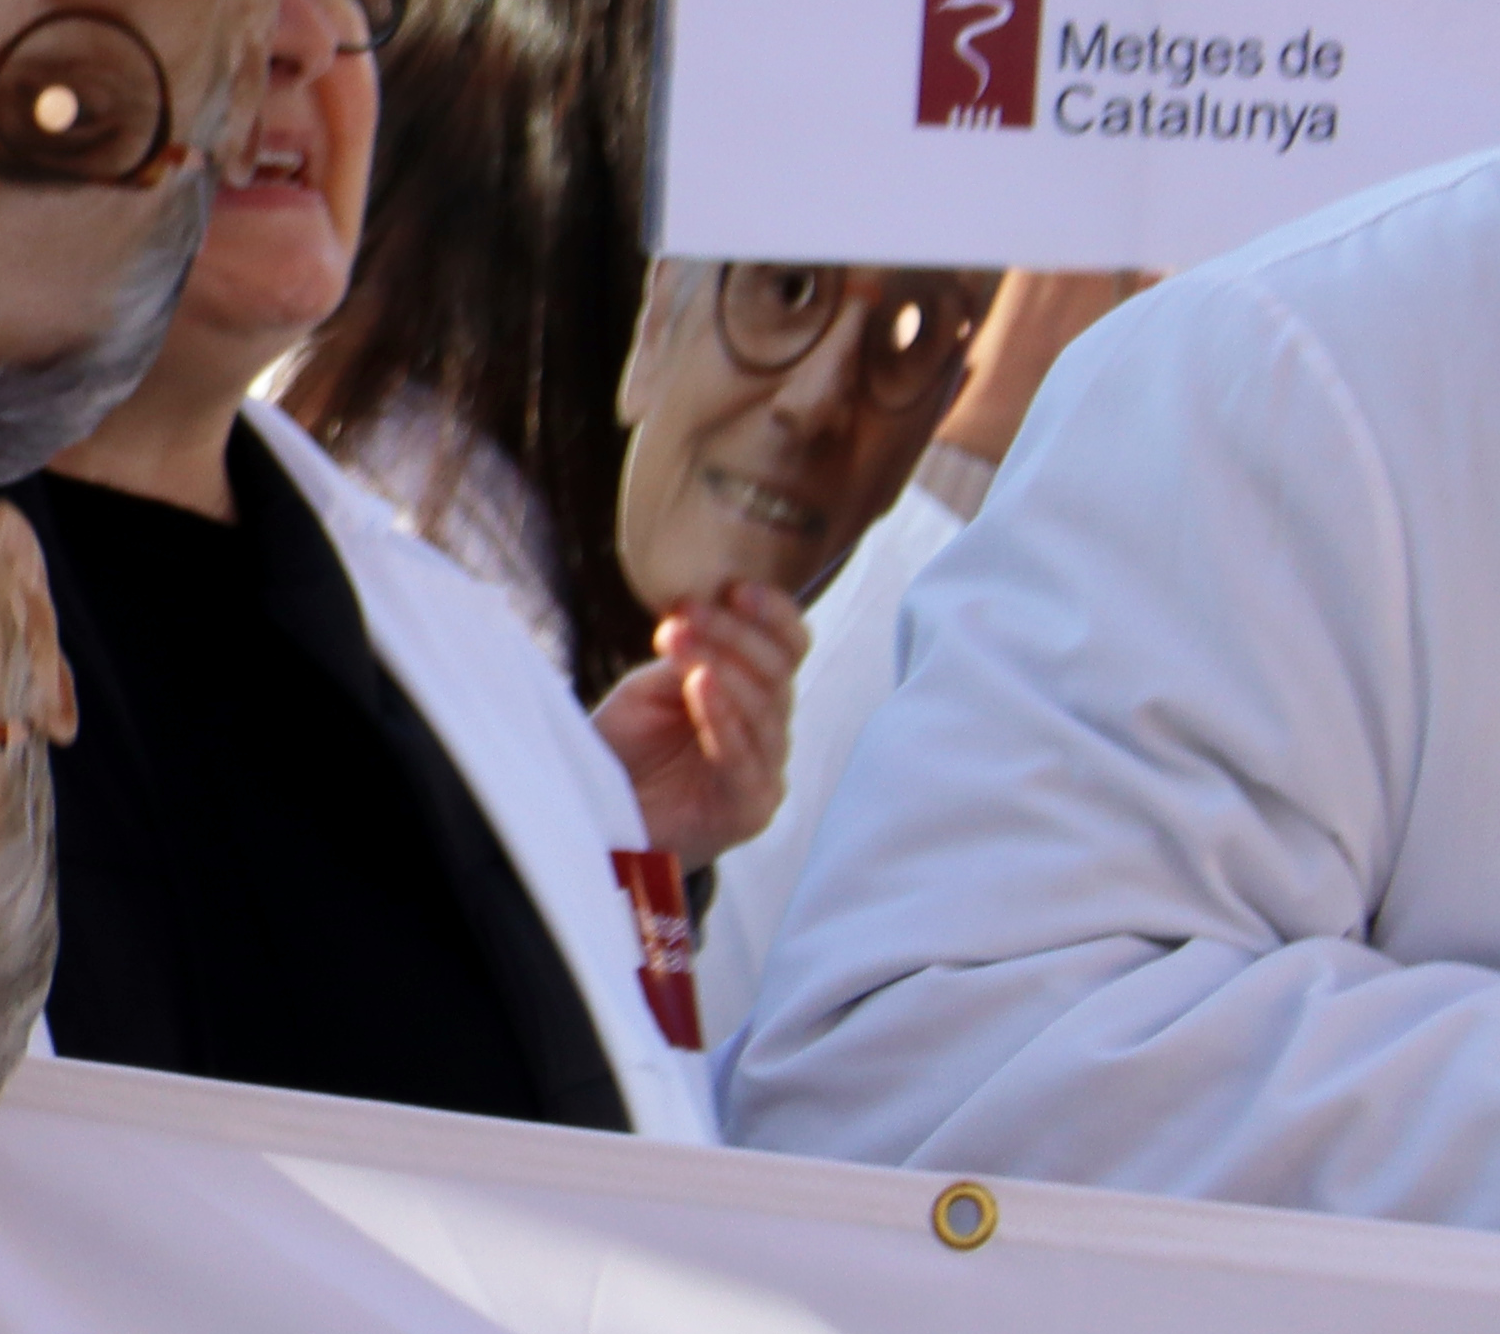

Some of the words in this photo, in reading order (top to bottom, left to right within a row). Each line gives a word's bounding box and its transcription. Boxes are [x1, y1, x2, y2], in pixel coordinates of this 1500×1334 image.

[1057, 21, 1264, 88] Metges
[1277, 29, 1344, 79] de
[1054, 85, 1339, 153] Catalunya
